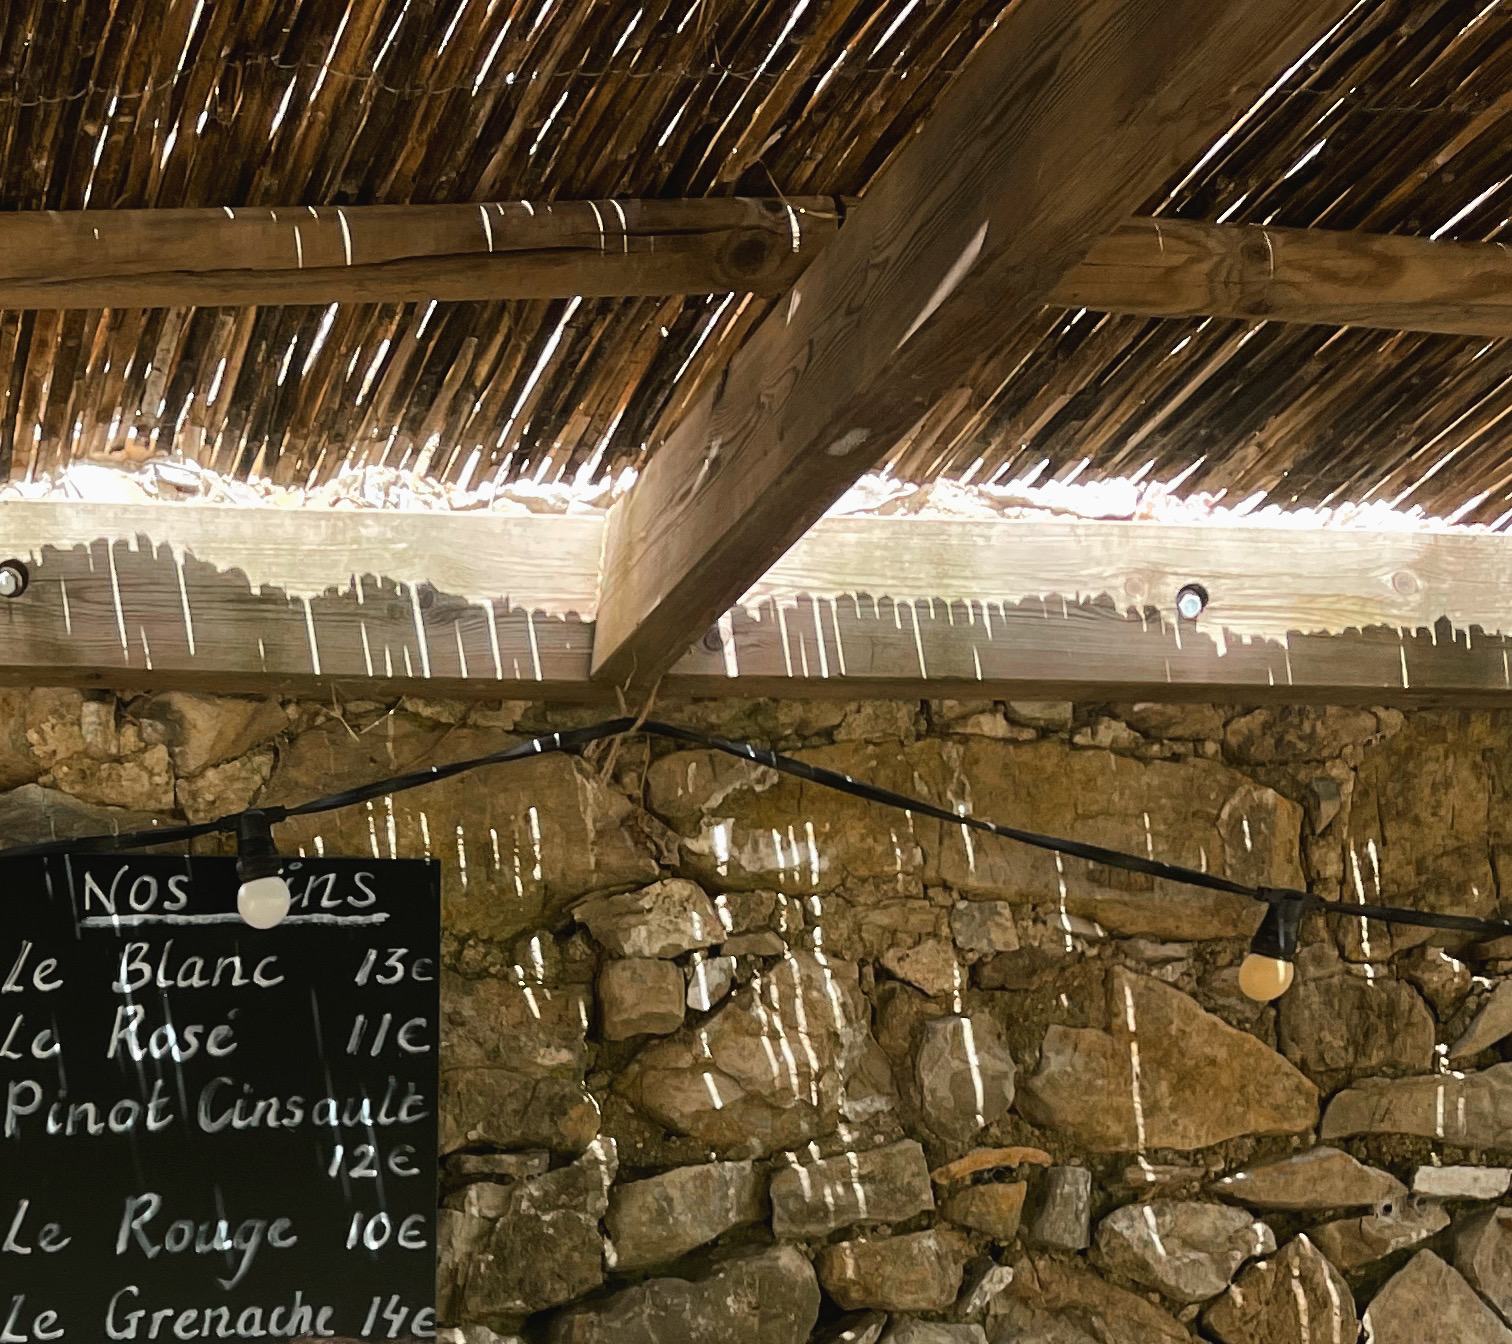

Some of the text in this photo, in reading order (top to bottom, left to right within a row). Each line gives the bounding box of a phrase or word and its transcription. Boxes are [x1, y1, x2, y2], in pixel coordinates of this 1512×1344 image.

[84, 862, 377, 912] Nos ins
[1, 941, 64, 994] Le
[111, 940, 285, 994] Blanc
[4, 1076, 429, 1138] Pinot Cinsault
[1, 1199, 72, 1255] Le
[116, 1192, 298, 1291] Rouge
[105, 1285, 336, 1341] Grenache
